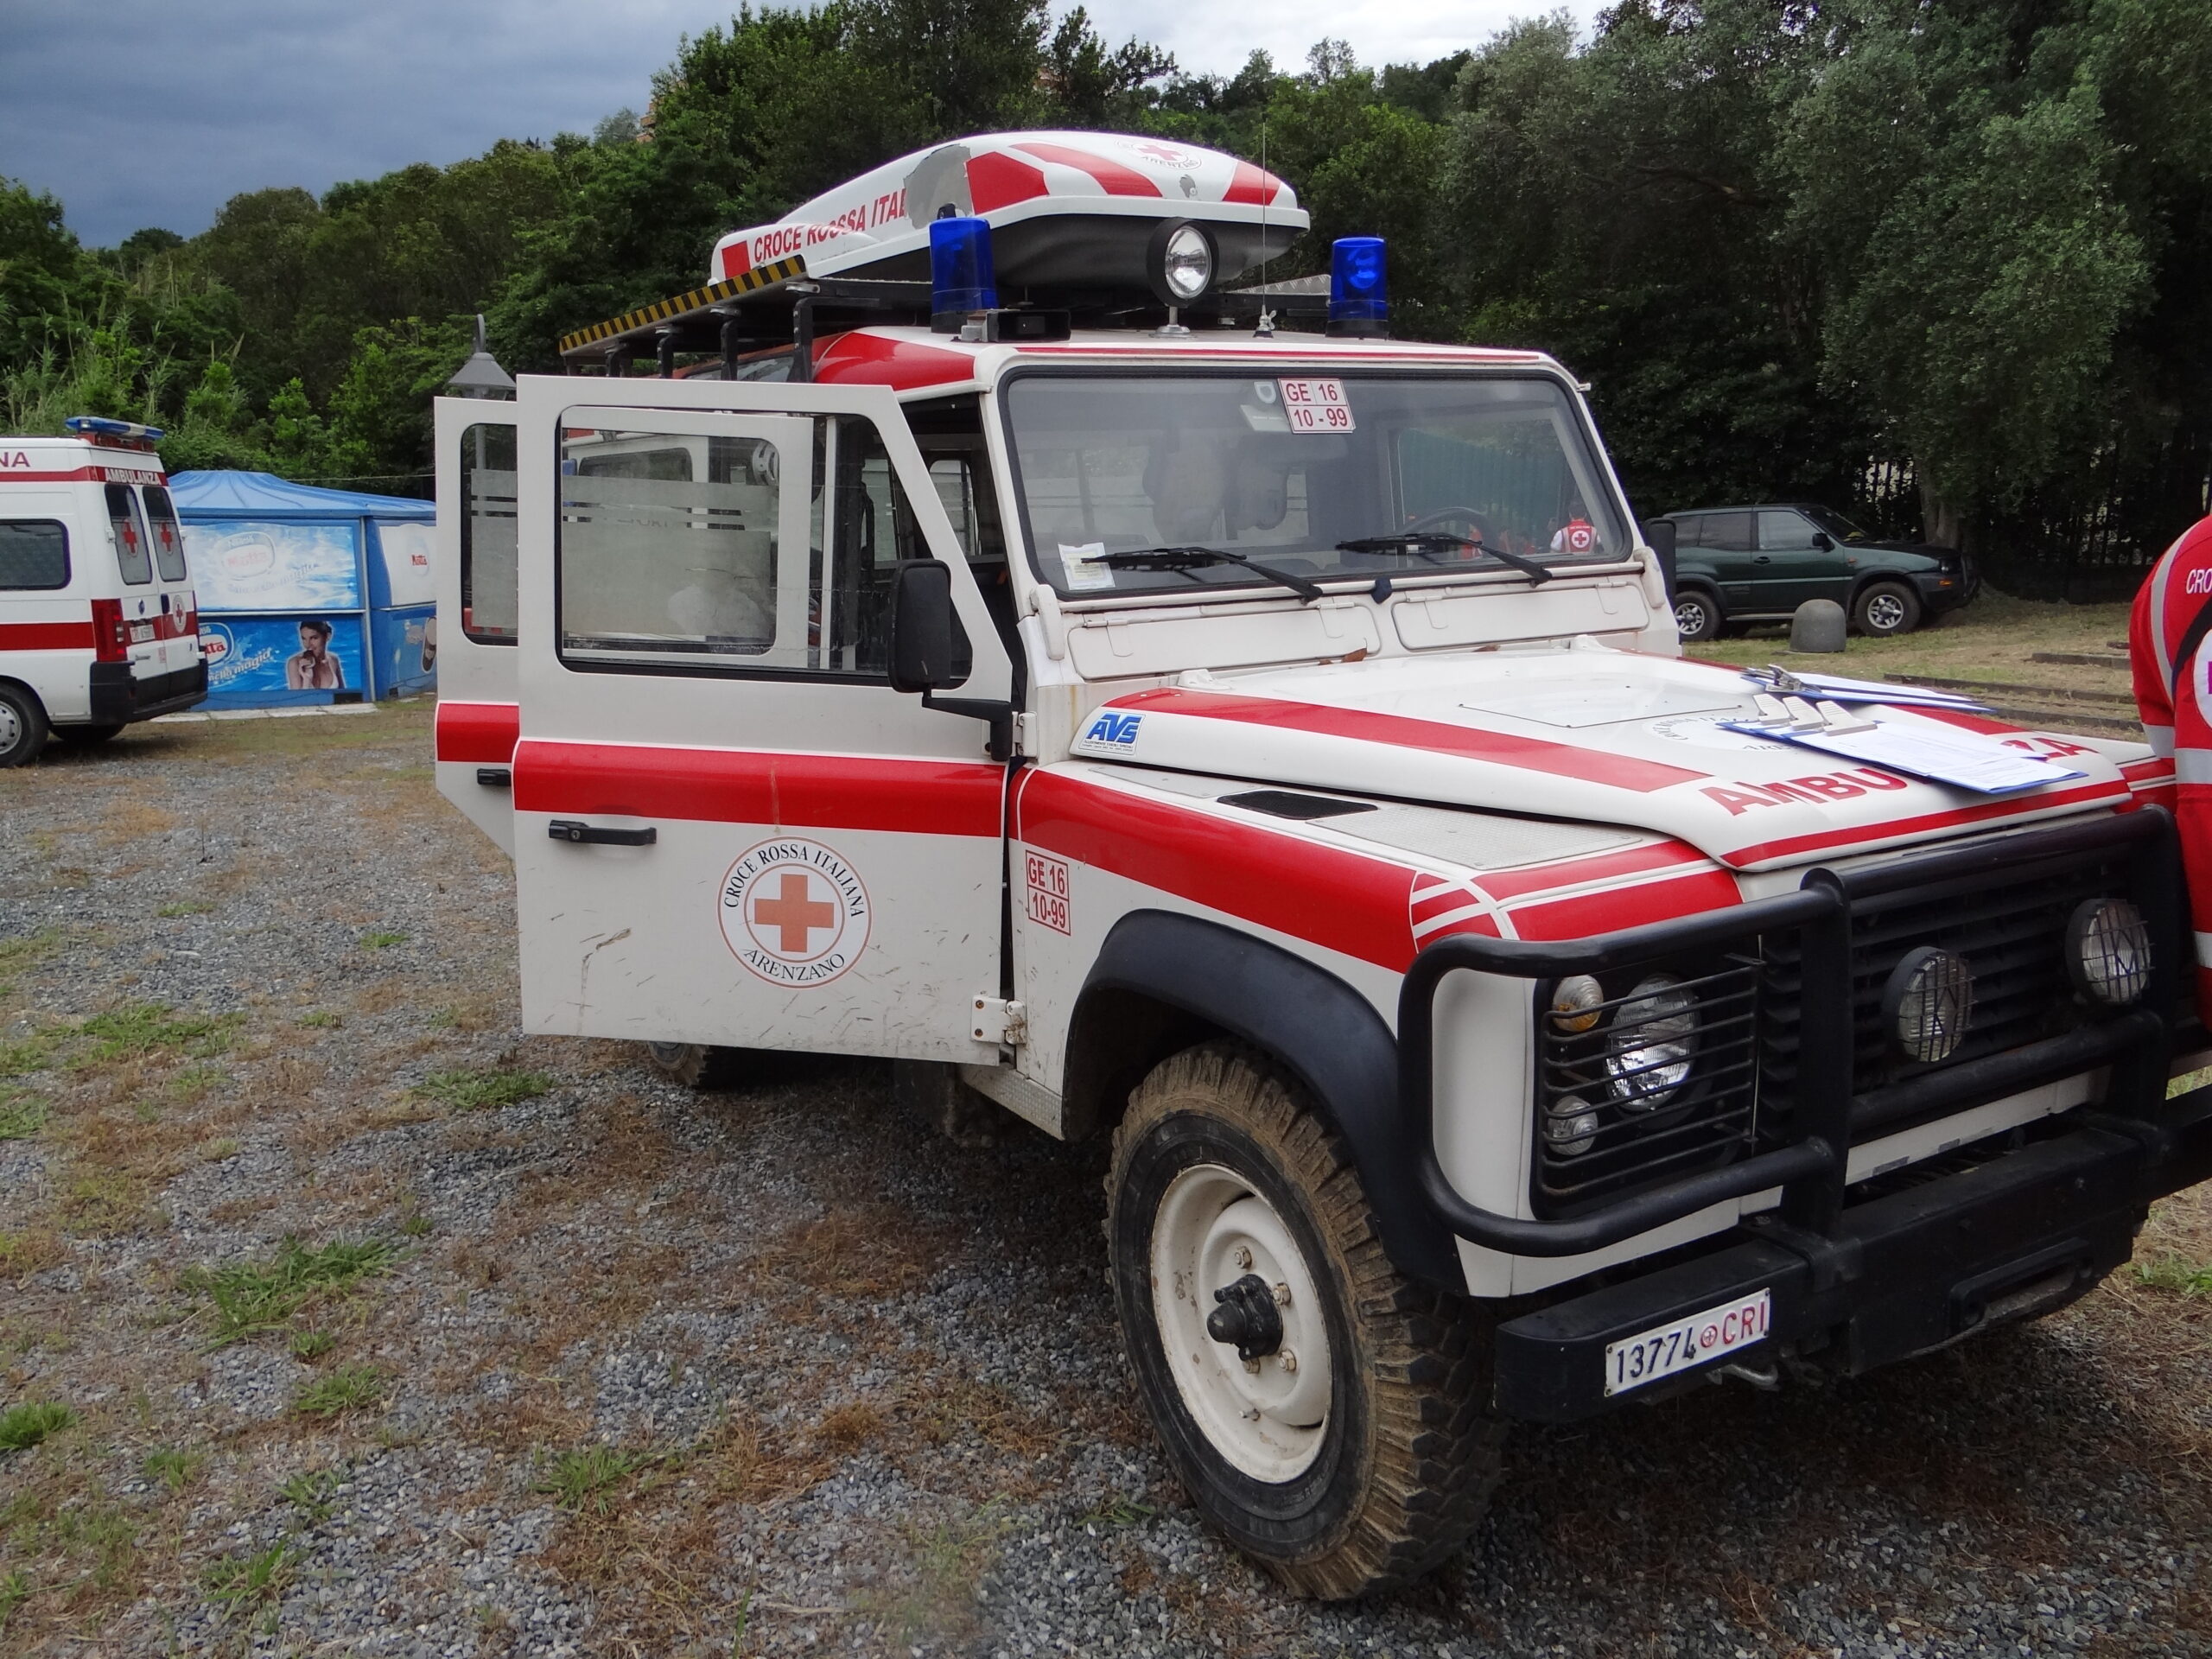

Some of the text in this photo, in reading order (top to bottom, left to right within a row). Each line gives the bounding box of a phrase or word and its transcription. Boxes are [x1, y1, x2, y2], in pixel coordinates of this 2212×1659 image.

[753, 226, 803, 263] CROCE
[806, 204, 866, 246] ROSSA
[1286, 383, 1338, 402] GE 16
[105, 467, 162, 485] AMBULANZA
[234, 646, 272, 673] magia
[1085, 714, 1142, 744] AVS
[724, 843, 865, 918] CROCE ROSSA ITALIANA
[1028, 857, 1065, 895] GE 16
[1033, 892, 1065, 929] 10-99
[743, 949, 845, 989] ARENZANO
[1617, 1301, 1765, 1384] 13774 CRI
